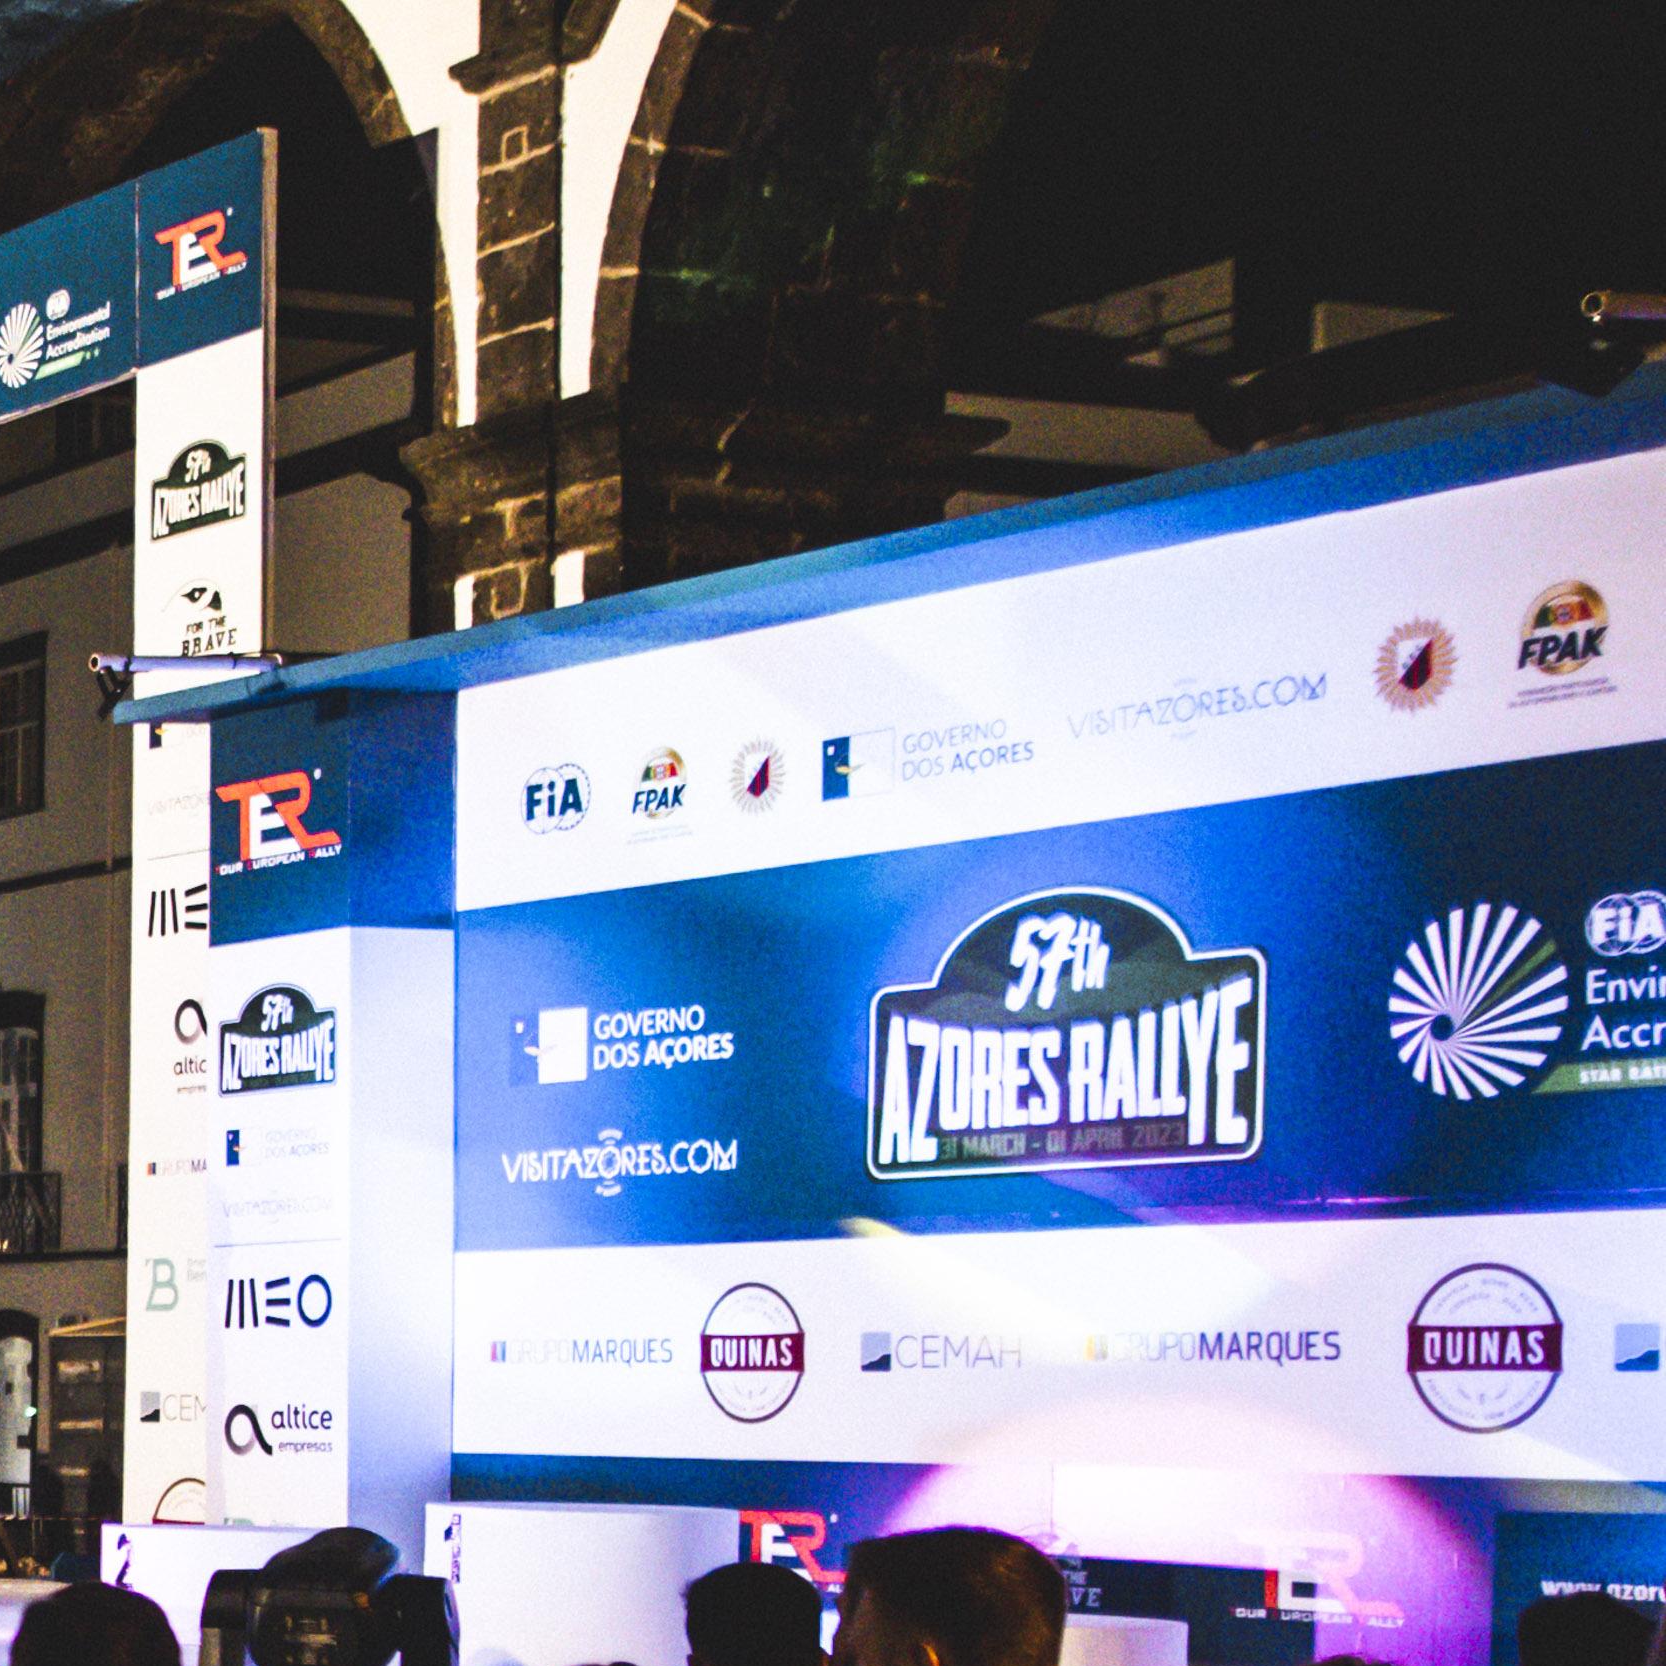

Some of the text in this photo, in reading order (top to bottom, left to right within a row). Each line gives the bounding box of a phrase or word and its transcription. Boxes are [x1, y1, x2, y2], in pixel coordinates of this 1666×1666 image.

[153, 461, 244, 538] AZORES RALLYE
[181, 629, 237, 657] BRAVE
[1517, 624, 1608, 670] FPAK
[902, 719, 1007, 755] GOVERNO
[902, 740, 1034, 782] DOS AÇORES
[215, 770, 341, 861] TER
[632, 782, 687, 816] FPAK
[1005, 911, 1109, 1011] 57th
[594, 1004, 705, 1040] GOVERNO
[222, 1017, 335, 1091] AZORES RALLYE
[594, 1032, 735, 1071] DOS AÇORES
[879, 972, 1254, 1165] AZORES RALLYE
[501, 1138, 738, 1183] VISITAZORES.COM
[967, 1132, 1026, 1159] MARCH
[225, 1274, 332, 1330] MEO
[709, 1336, 793, 1368] QUINAS
[893, 1333, 1023, 1371] CEMAH
[1424, 1329, 1546, 1366] QUINAS
[271, 1403, 334, 1431] altice
